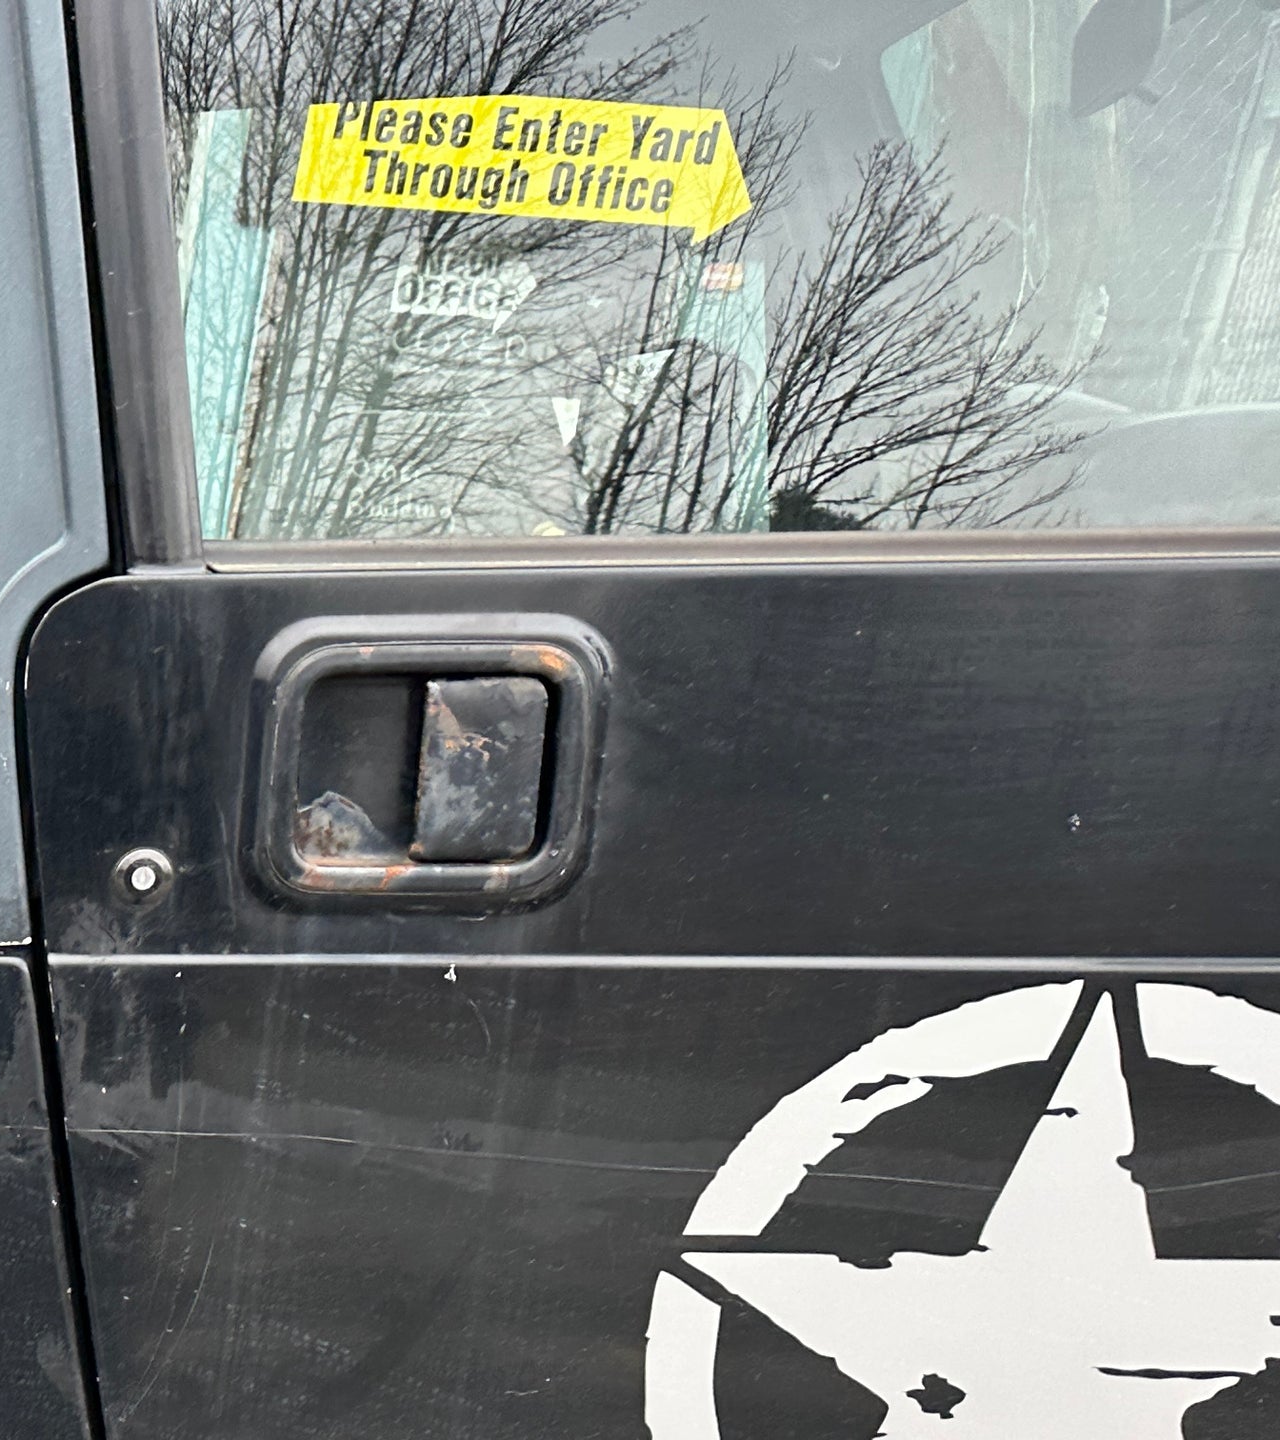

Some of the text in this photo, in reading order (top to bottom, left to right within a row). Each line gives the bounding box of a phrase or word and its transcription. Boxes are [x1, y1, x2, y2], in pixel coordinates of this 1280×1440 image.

[334, 101, 722, 166] Please Enter Yard
[363, 148, 675, 214] Through Office
